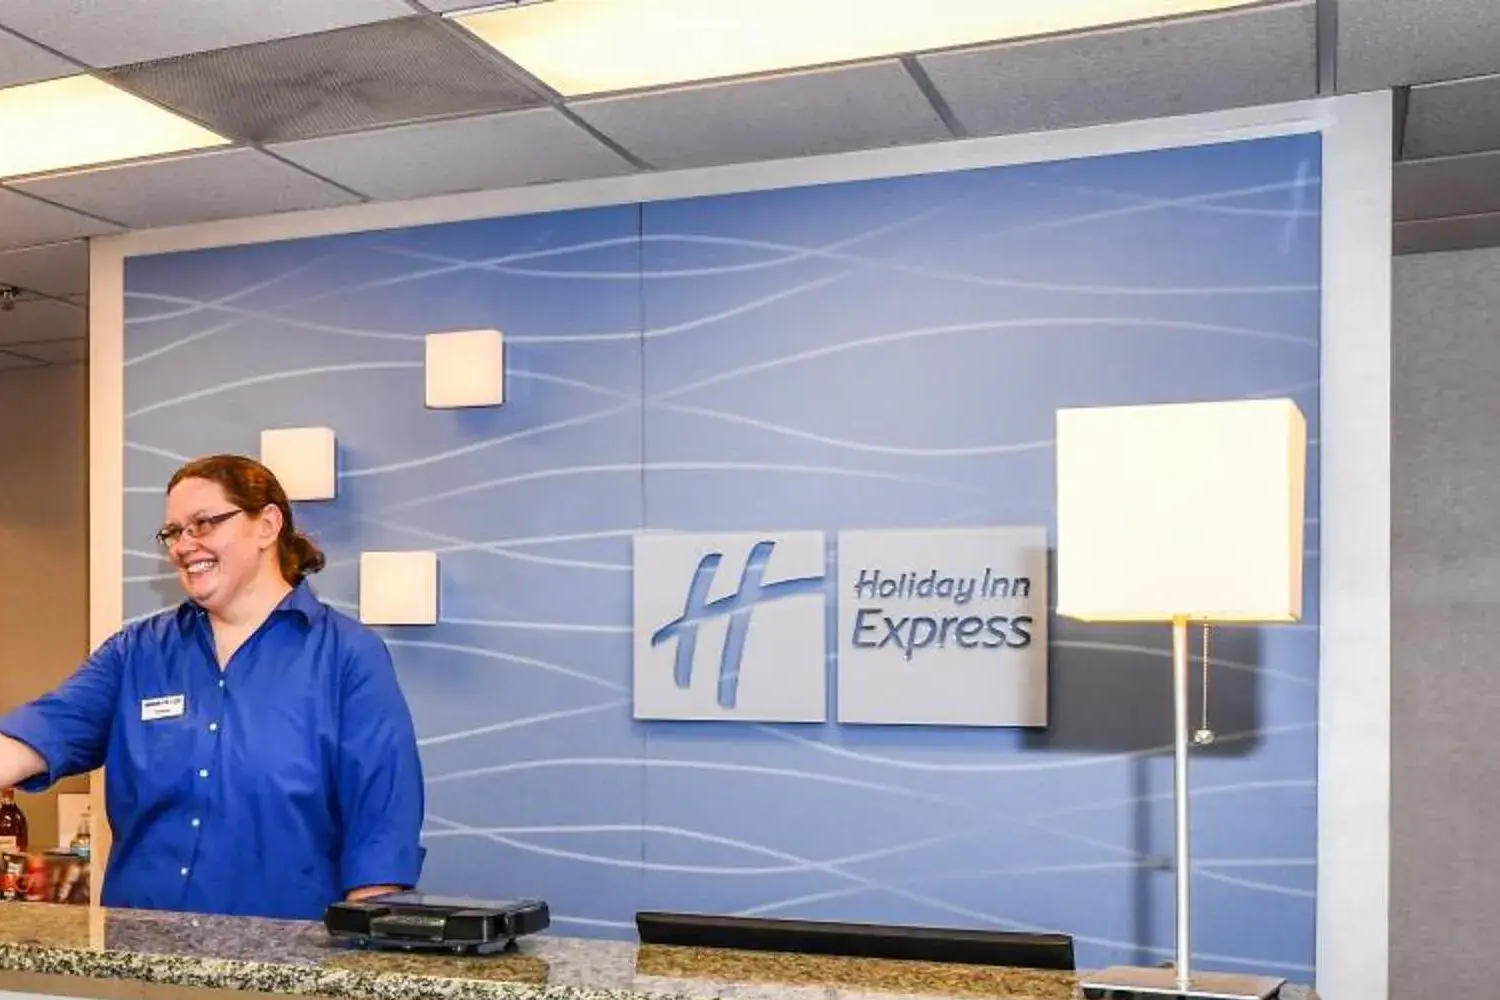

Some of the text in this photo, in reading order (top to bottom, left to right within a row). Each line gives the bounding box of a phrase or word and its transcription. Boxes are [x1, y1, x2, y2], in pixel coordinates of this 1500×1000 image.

[854, 567, 1031, 604] Holiday Inn
[852, 608, 1033, 662] Express
